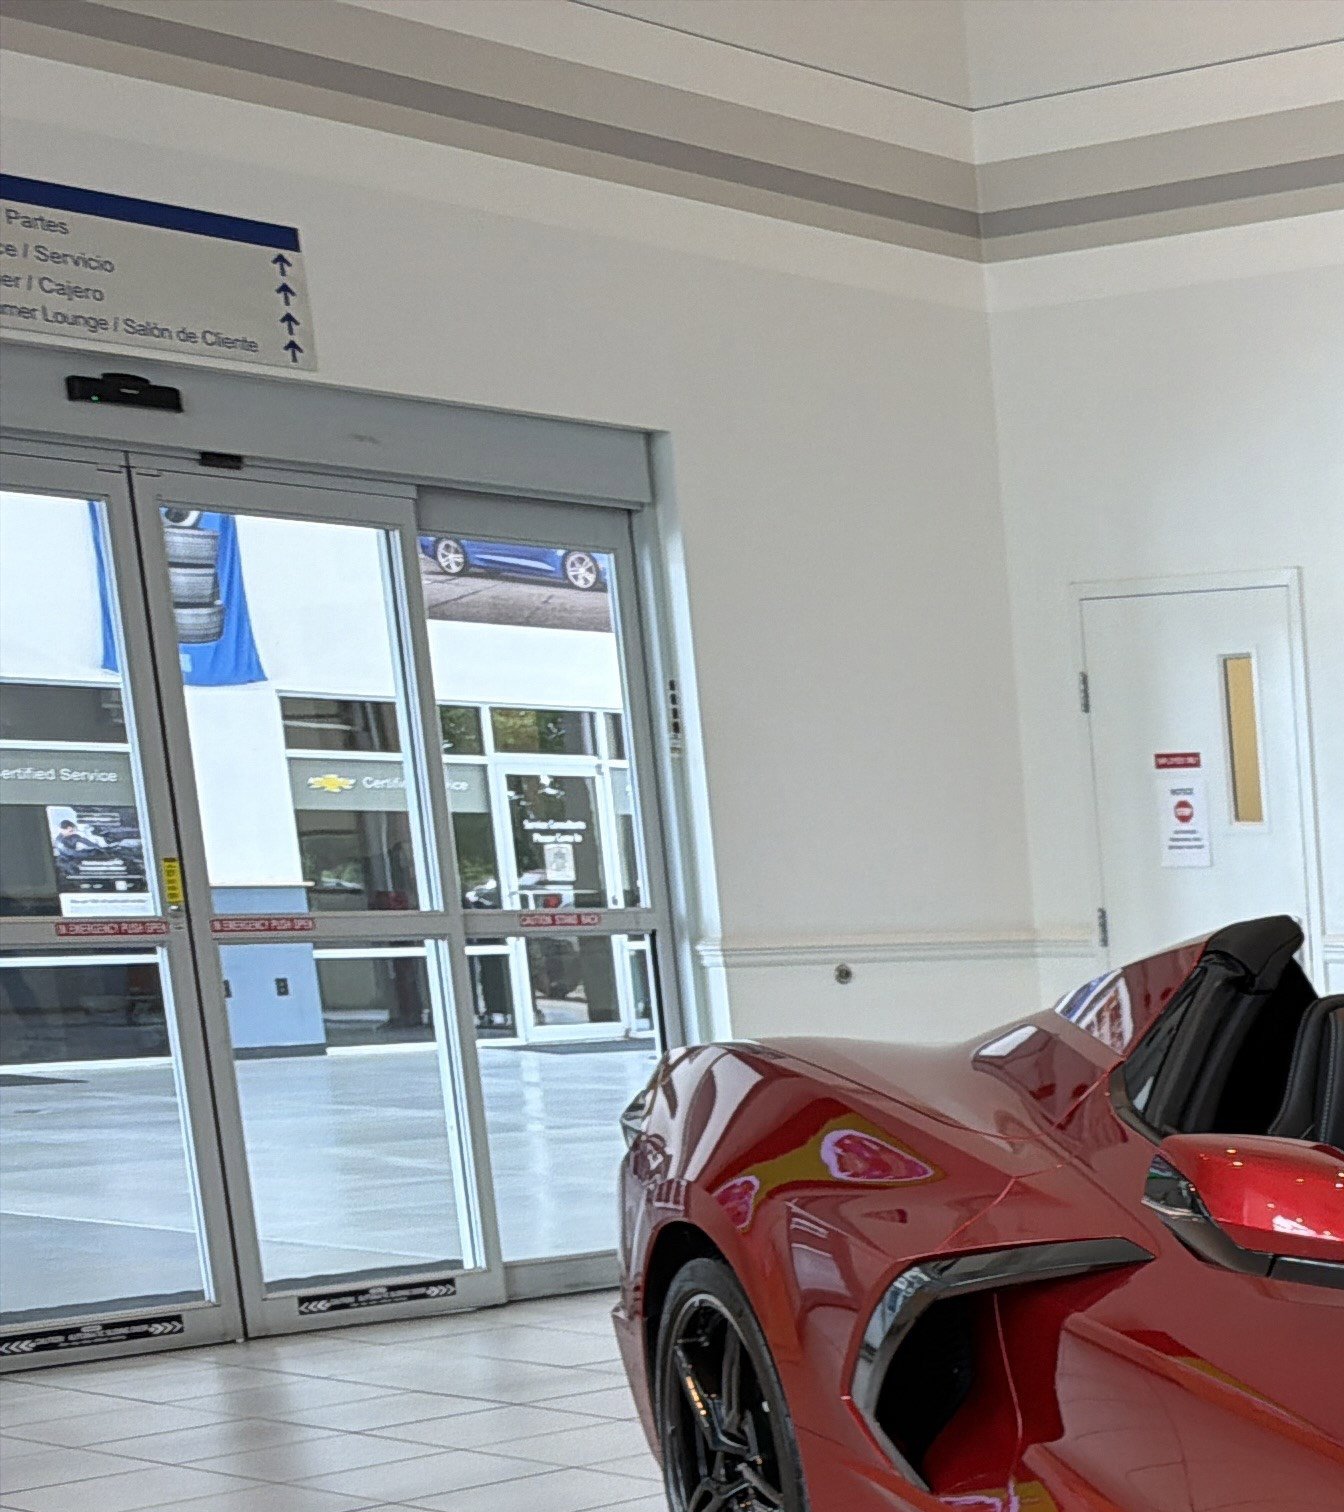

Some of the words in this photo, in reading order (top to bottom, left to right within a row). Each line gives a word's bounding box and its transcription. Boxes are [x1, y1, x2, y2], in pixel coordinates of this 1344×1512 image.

[5, 208, 69, 235] Partes
[34, 244, 115, 273] Servicio
[39, 276, 105, 302] Cajero
[41, 304, 109, 334] Lounge
[176, 327, 198, 344] de
[201, 330, 259, 353] Cliente
[59, 768, 118, 782] Service
